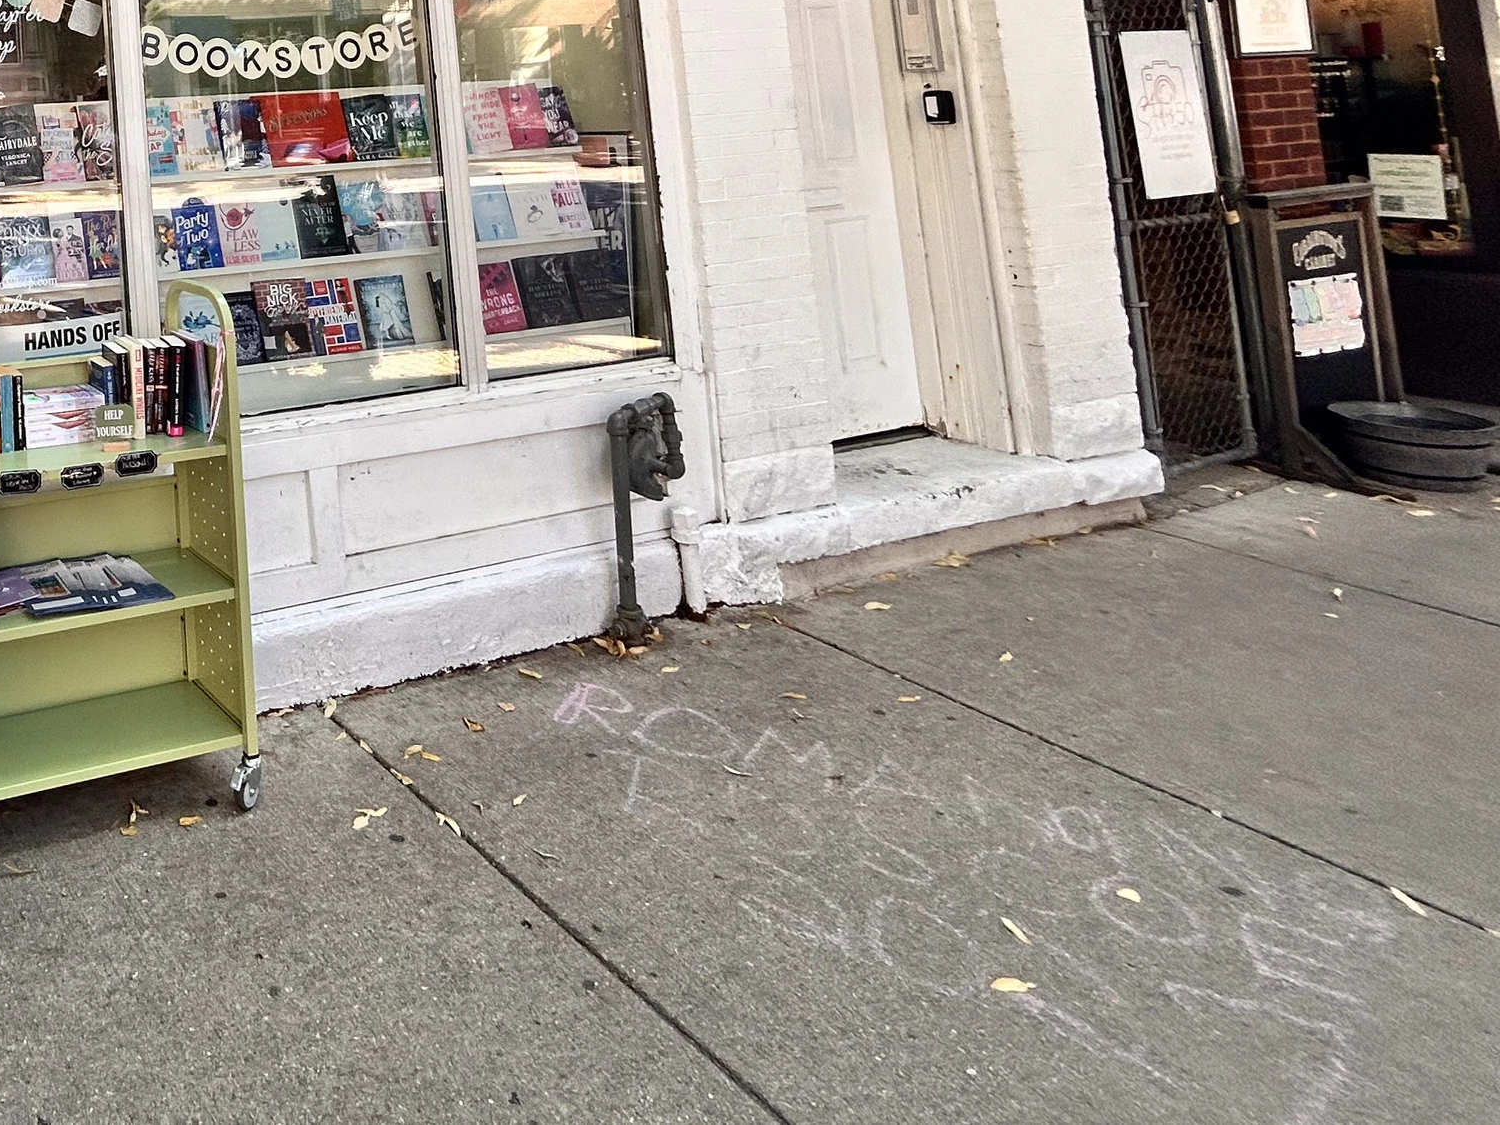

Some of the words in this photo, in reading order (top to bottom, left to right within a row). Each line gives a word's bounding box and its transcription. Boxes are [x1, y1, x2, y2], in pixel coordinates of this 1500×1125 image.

[142, 20, 417, 72] BOOKSTORE
[350, 111, 388, 127] Keep
[472, 111, 497, 122] FROM
[543, 108, 560, 120] YOU
[360, 126, 387, 143] Me
[476, 131, 501, 141] LIGHT
[551, 191, 583, 208] FAULT
[174, 212, 208, 233] Party
[183, 228, 209, 245] Two
[226, 229, 259, 241] FLAW
[233, 240, 261, 253] LESS
[269, 283, 292, 295] BIG
[266, 292, 299, 307] NICK
[25, 325, 87, 351] HANDS
[92, 320, 121, 342] OFF
[103, 409, 124, 421] HELP
[96, 424, 134, 438] YOURSELF
